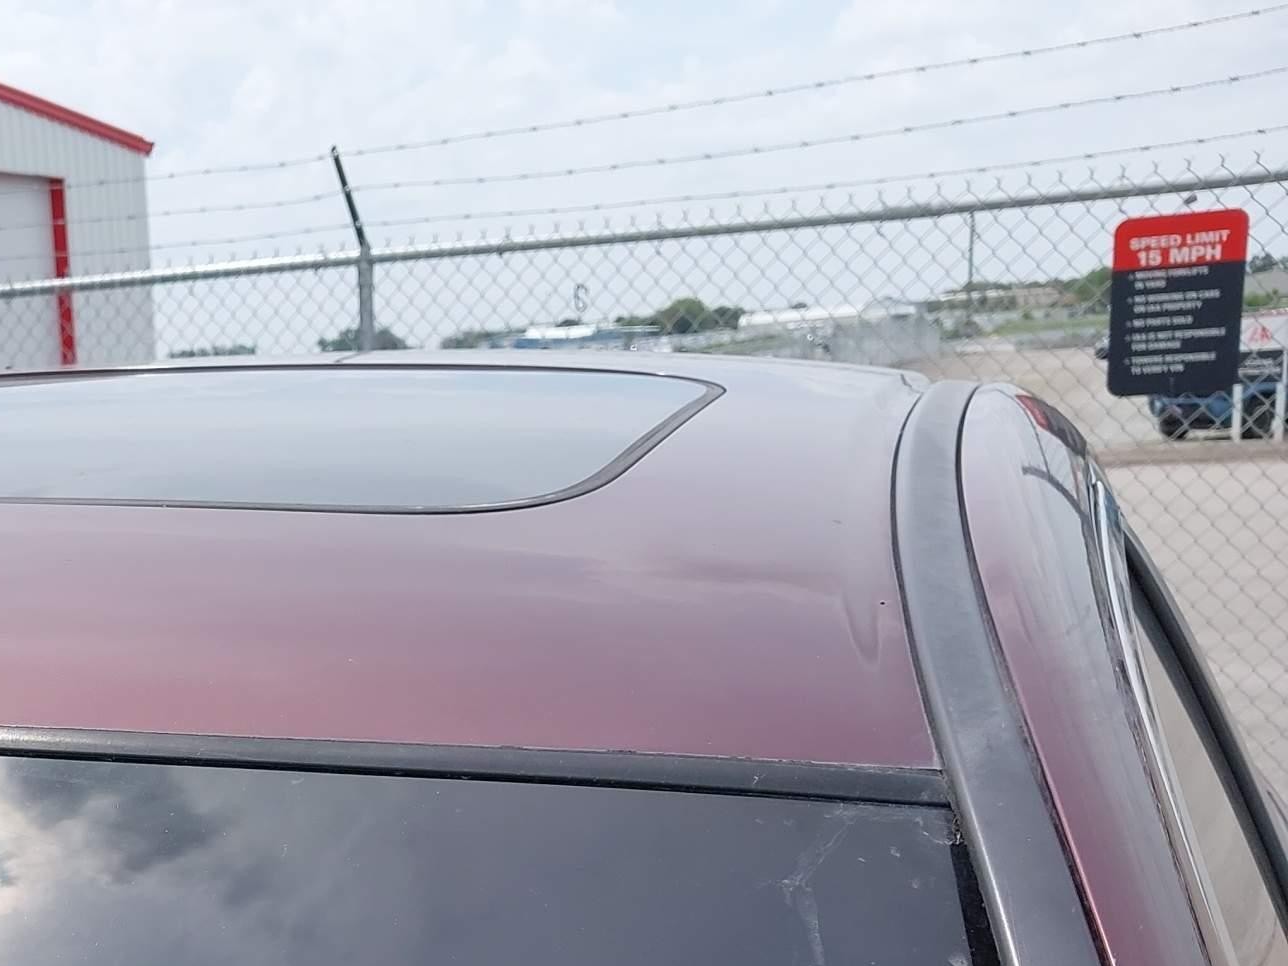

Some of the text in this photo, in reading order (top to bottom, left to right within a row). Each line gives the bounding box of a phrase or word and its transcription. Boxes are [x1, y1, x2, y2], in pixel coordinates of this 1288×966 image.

[1129, 229, 1231, 251] SPEED LIMIT
[1137, 244, 1223, 267] 15 MPH
